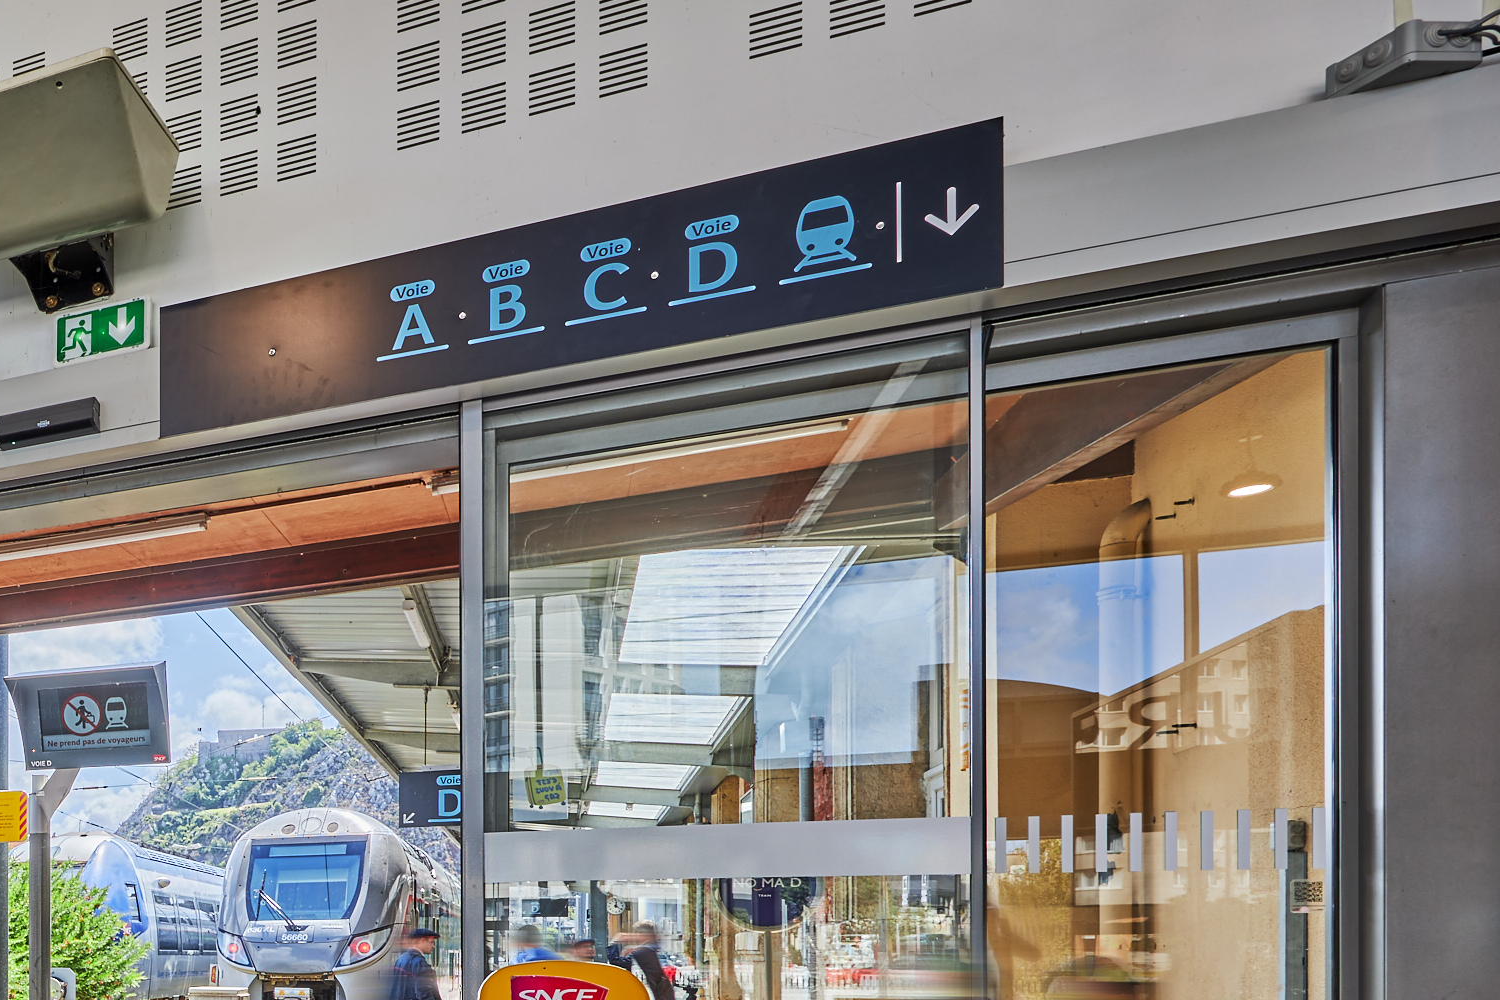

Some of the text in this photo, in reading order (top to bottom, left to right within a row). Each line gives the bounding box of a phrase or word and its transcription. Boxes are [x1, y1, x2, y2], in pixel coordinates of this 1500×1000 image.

[692, 219, 732, 237] Voie
[586, 242, 624, 259] Voie
[488, 263, 523, 280] Voie
[688, 242, 738, 293] D
[395, 283, 430, 300] Voie
[583, 262, 630, 311] C
[489, 284, 526, 331] B
[392, 303, 435, 351] A
[47, 736, 146, 749] Ne prend pas de voyageurs
[30, 760, 46, 768] VOIE
[440, 777, 461, 785] Voie
[438, 789, 461, 817] D
